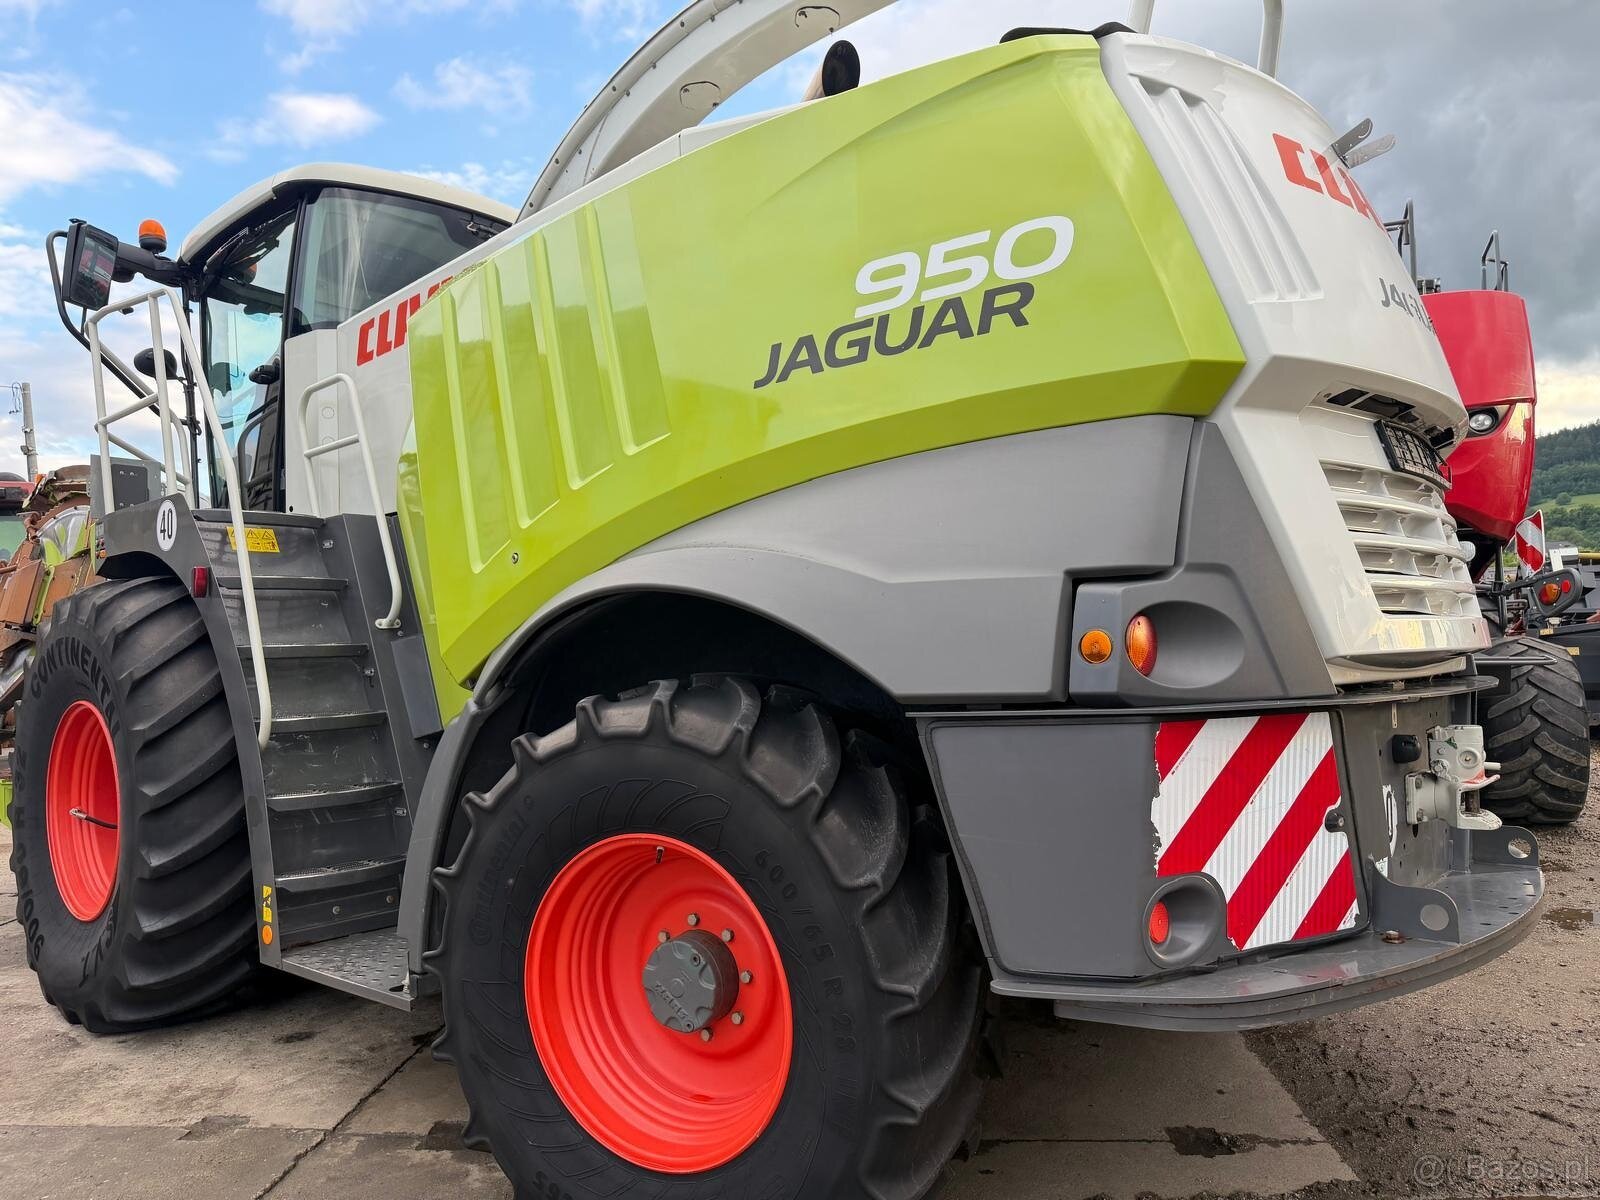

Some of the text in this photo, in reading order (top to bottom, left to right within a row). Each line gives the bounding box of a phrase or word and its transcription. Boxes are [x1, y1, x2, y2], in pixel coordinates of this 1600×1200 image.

[1272, 133, 1389, 237] CLA
[855, 215, 1075, 318] 950
[356, 275, 453, 367] CLA
[753, 282, 1035, 389] JAGUAR
[159, 509, 173, 541] 40
[31, 637, 121, 735] CONTINENTAL
